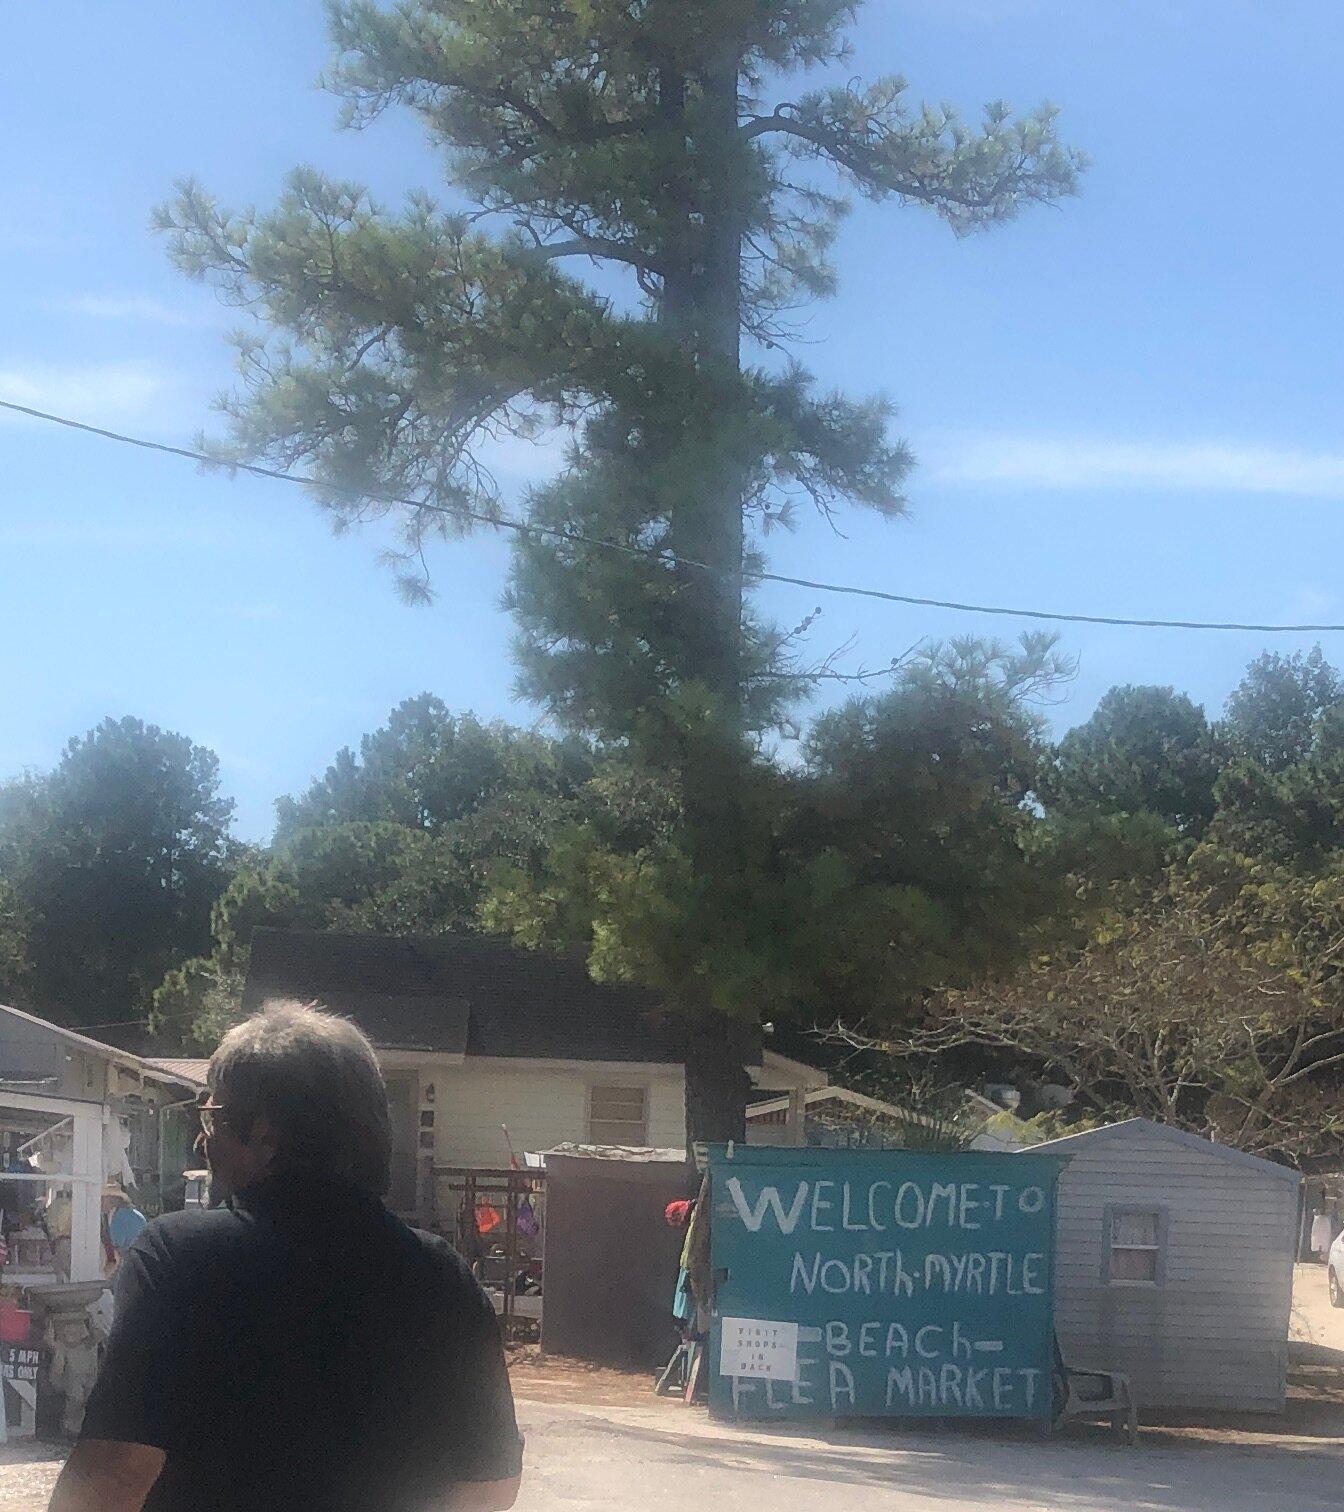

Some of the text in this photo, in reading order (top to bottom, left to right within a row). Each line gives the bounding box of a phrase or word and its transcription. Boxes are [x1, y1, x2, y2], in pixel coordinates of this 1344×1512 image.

[725, 1176, 1045, 1235] WELCOME TO
[738, 1327, 778, 1336] VISIT
[737, 1339, 777, 1349] SHOPS
[751, 1353, 764, 1361] IN
[885, 1363, 1042, 1409] MARKET
